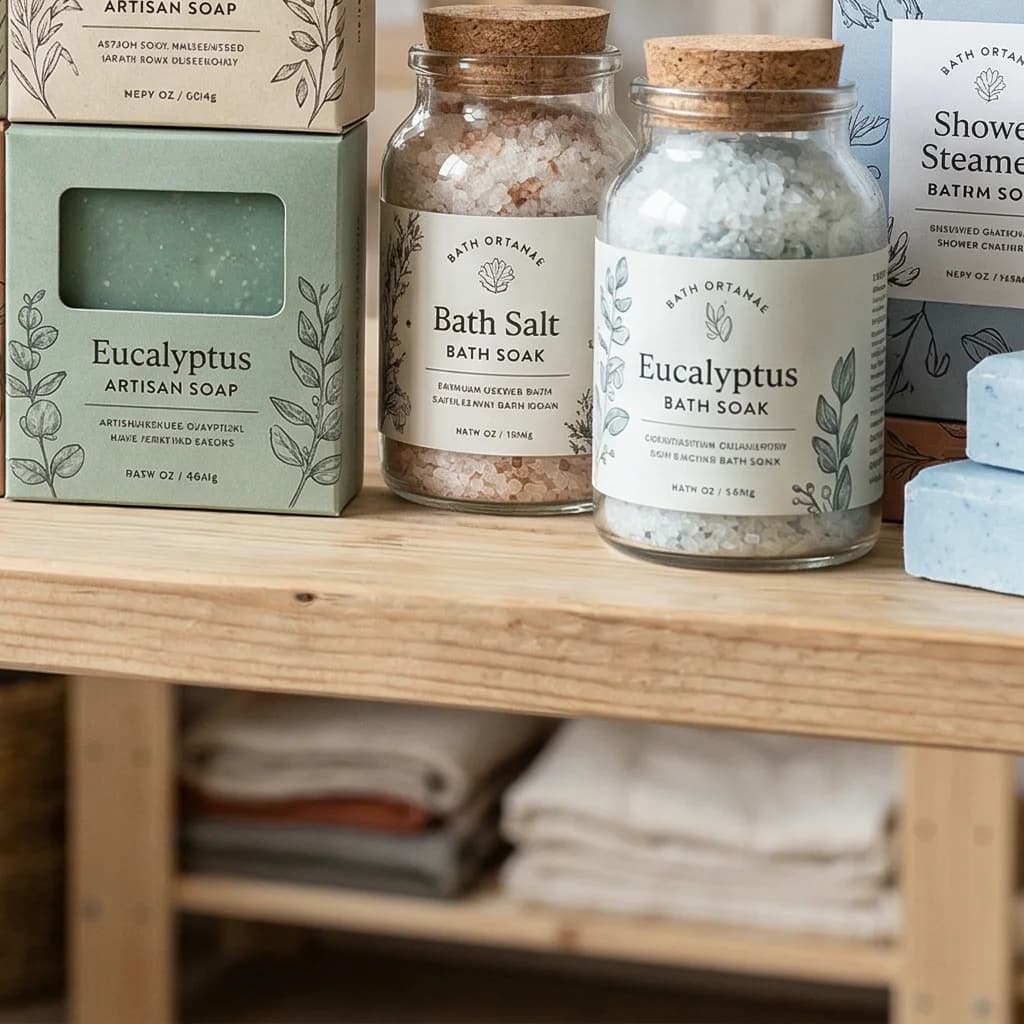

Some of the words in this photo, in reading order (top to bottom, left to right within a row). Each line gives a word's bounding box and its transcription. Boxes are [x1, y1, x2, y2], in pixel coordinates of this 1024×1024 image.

[105, 0, 180, 13] ARTISAN
[189, 2, 236, 15] SOAP
[941, 50, 974, 75] BATH
[159, 91, 174, 99] OZ
[177, 91, 183, 101] /
[935, 111, 1024, 140] Showe
[922, 144, 1024, 175] Steame
[447, 239, 479, 263] BATH
[938, 239, 978, 249] SHOWER
[975, 272, 989, 280] OZ
[666, 284, 698, 309] BATH
[434, 306, 496, 335] Bath
[506, 311, 559, 336] Salt
[92, 339, 251, 376] Eucalyptus
[447, 345, 489, 360] BATH
[497, 349, 544, 362] SOAK
[640, 353, 797, 394] Eucalyptus
[105, 379, 182, 394] ARTISAN
[190, 382, 237, 396] SOAP
[665, 396, 709, 413] BATH
[717, 401, 768, 415] SOAK
[160, 471, 174, 480] OZ
[701, 487, 714, 495] OZ
